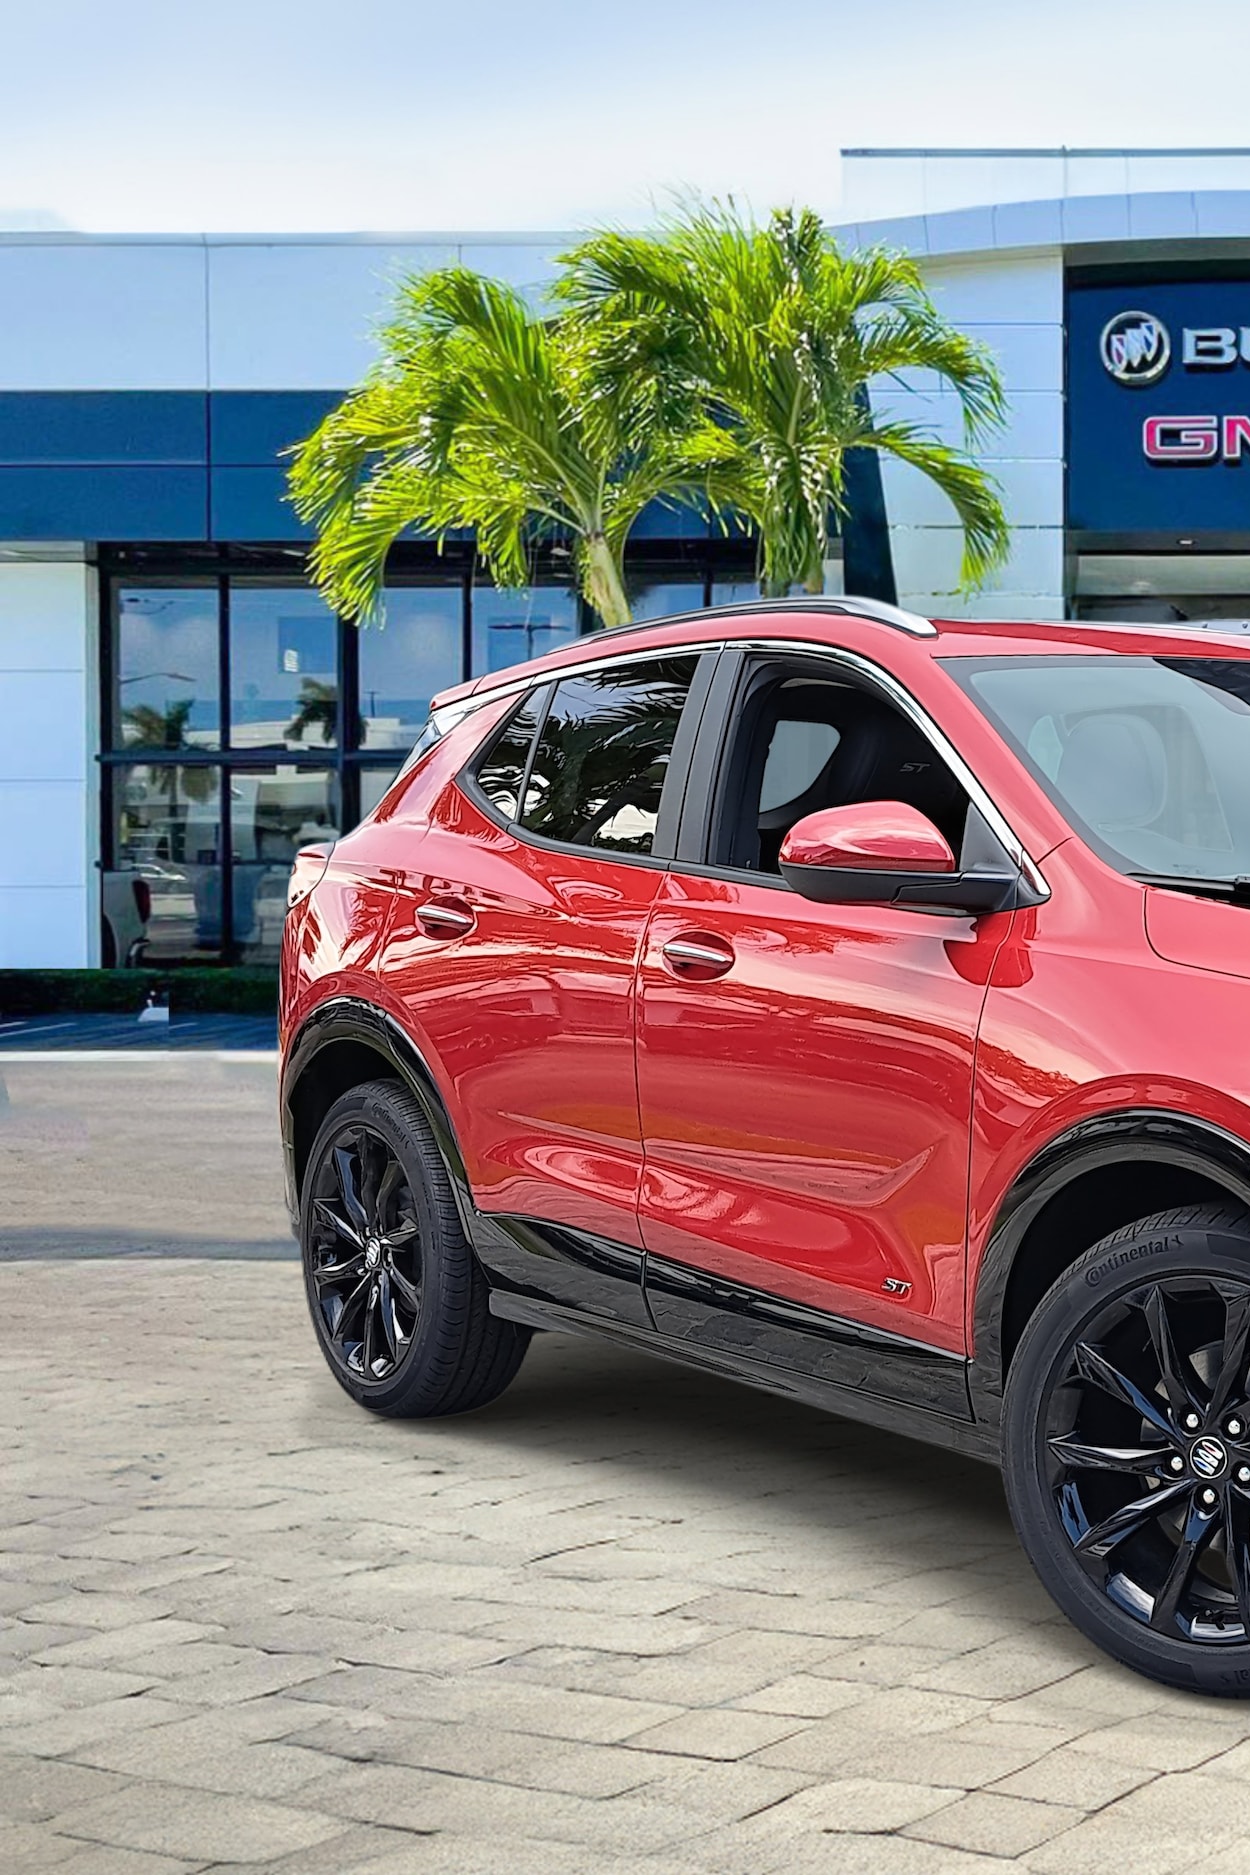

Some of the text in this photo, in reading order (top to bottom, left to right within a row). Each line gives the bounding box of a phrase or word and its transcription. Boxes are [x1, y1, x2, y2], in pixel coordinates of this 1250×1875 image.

[899, 762, 931, 774] ST
[1084, 1236, 1171, 1288] Continental
[881, 1276, 912, 1295] ST
